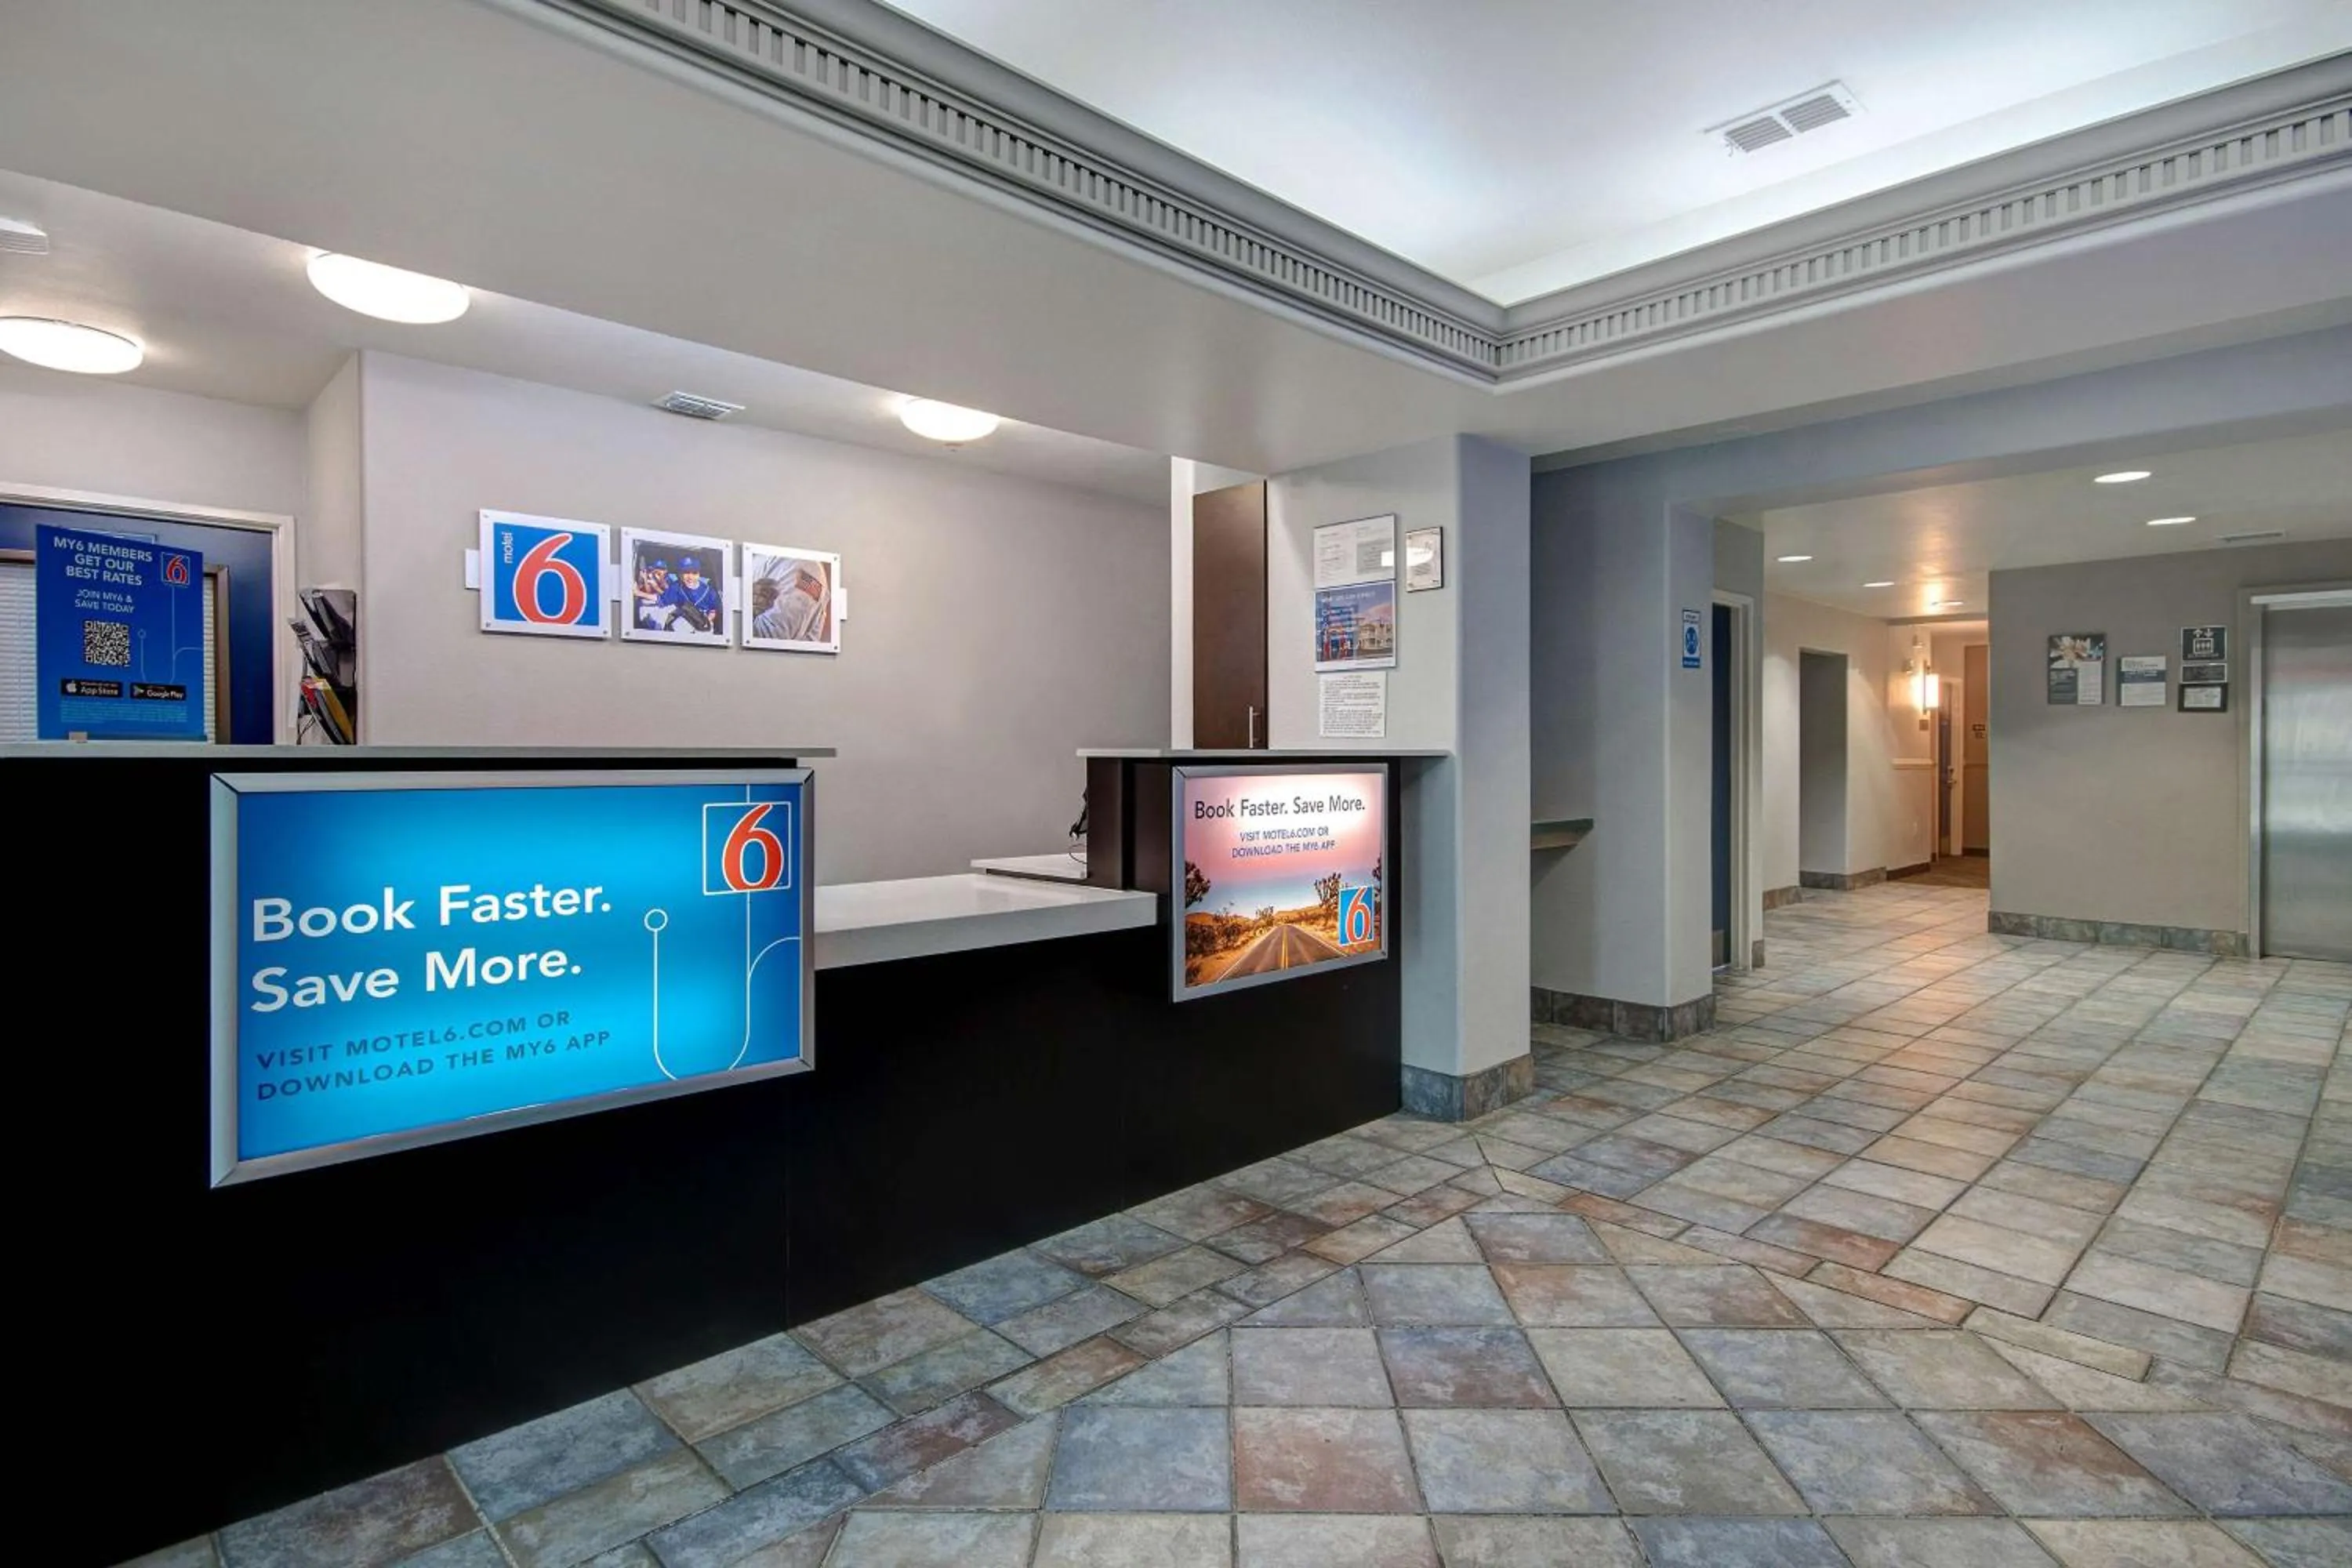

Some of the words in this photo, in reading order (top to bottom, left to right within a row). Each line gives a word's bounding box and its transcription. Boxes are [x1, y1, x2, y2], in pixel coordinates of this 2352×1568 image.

[53, 535, 84, 551] MY6
[88, 542, 153, 562] MEMBERS
[66, 565, 99, 581] BEST
[103, 571, 142, 586] RATES
[74, 553, 101, 567] GET
[105, 559, 134, 572] OUR
[166, 554, 187, 584] 6
[513, 533, 586, 626] 6
[74, 599, 99, 610] SAVE
[103, 602, 134, 613] TODAY
[77, 589, 100, 600] JOIN
[103, 592, 123, 602] MY6
[81, 687, 97, 695] App
[1195, 798, 1235, 819] Book
[1240, 798, 1288, 817] Faster.
[1293, 796, 1324, 815] Save
[1329, 794, 1366, 812] More.
[722, 803, 784, 891] 6
[1240, 831, 1260, 841] VISIT
[1317, 826, 1329, 837] OR
[1232, 844, 1283, 858] DOWNLOAD
[1286, 843, 1300, 853] THE
[253, 886, 416, 942] Book
[439, 883, 612, 927] Faster.
[1345, 887, 1372, 944] 6
[251, 966, 399, 1013] Save
[425, 947, 582, 992] More.
[256, 1044, 332, 1071] VISIT
[346, 1017, 526, 1058] MOTEL6.COM
[537, 1011, 570, 1029] OR
[258, 1058, 434, 1100] DOWNLOAD
[446, 1048, 493, 1071] THE
[506, 1040, 555, 1061] MY6
[566, 1030, 610, 1051] APP
